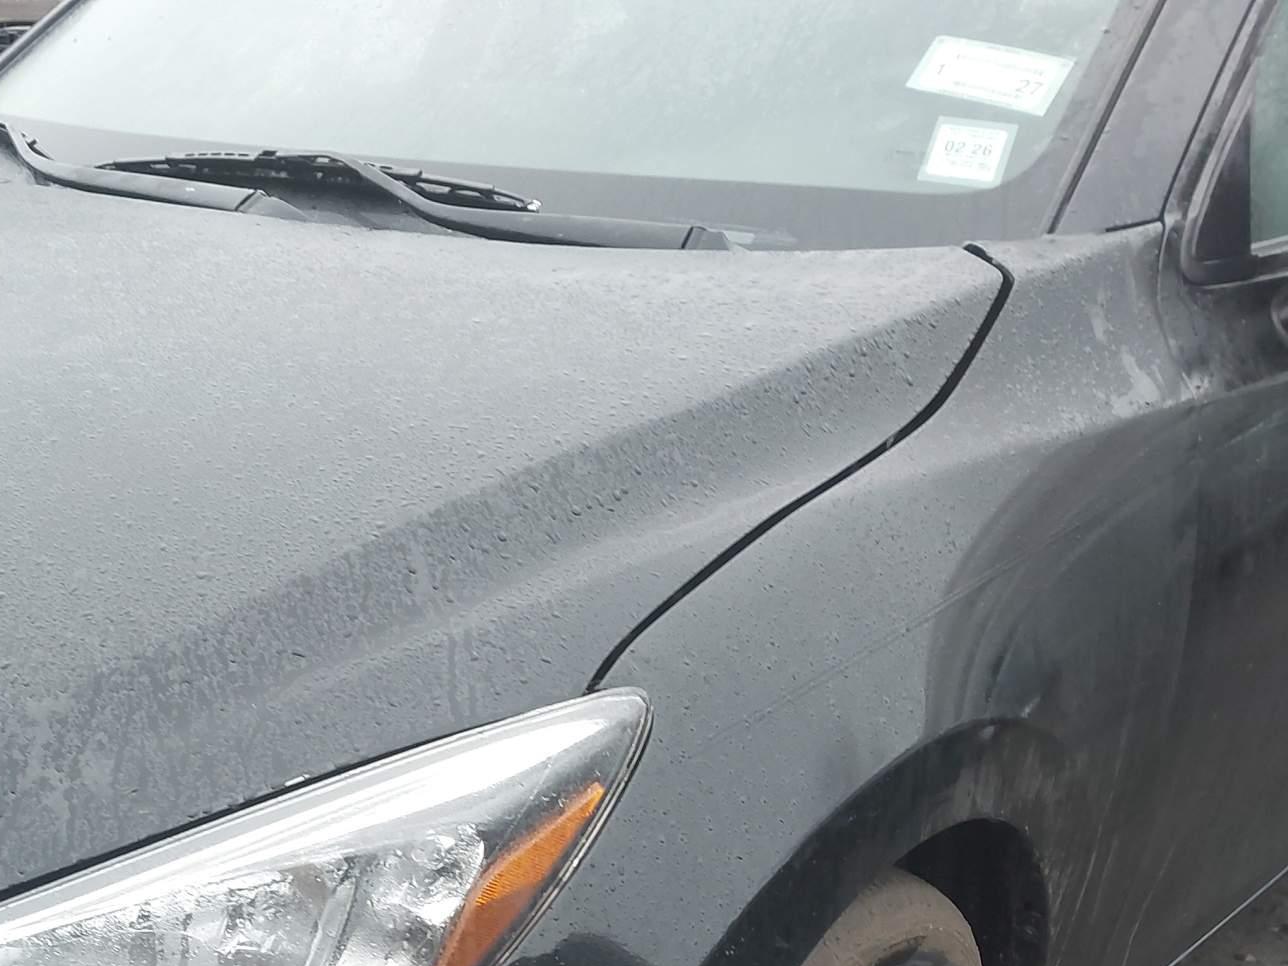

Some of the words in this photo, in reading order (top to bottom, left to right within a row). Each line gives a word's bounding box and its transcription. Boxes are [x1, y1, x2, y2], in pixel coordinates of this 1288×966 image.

[1016, 80, 1044, 95] 27
[944, 140, 966, 153] 02
[971, 143, 993, 156] 26
